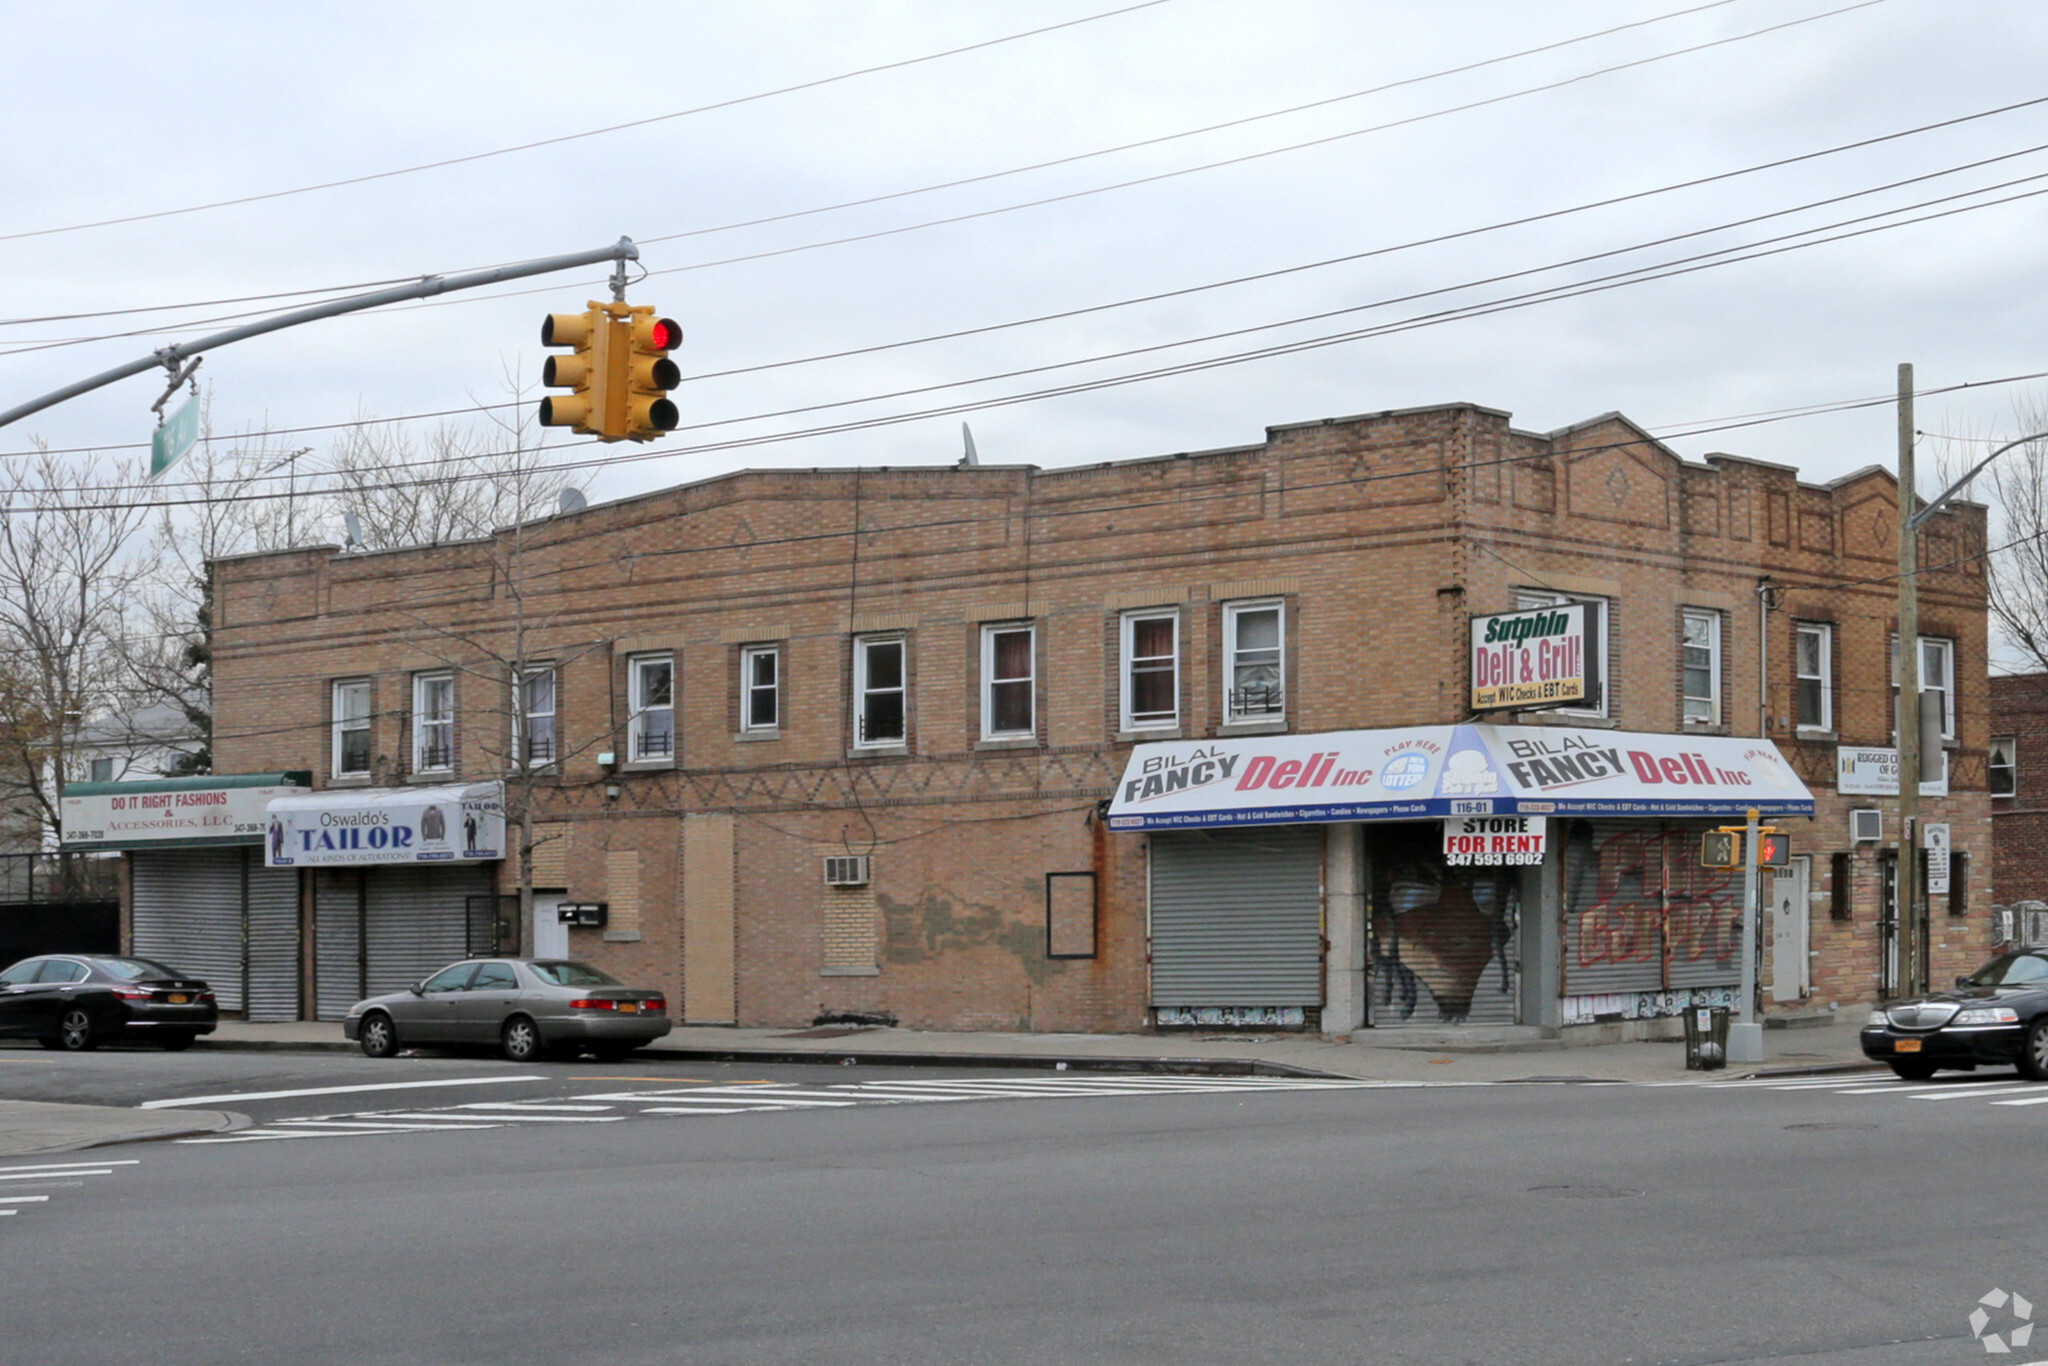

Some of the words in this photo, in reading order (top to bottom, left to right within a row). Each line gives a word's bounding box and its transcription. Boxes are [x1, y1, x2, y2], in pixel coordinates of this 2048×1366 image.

[1484, 610, 1569, 649] Sutphin
[1477, 643, 1515, 688] Deli
[1520, 647, 1534, 684] &
[1538, 635, 1581, 681] Grill
[1477, 691, 1496, 706] Accept
[1499, 686, 1514, 702] WIC
[1516, 686, 1536, 700] Checks
[1537, 684, 1543, 698] &
[1544, 682, 1560, 698] EBT
[1561, 683, 1579, 697] Cards
[1383, 740, 1413, 757] PLAY
[1415, 739, 1442, 755] HERE
[1507, 735, 1601, 759] BILAL
[1143, 745, 1226, 775] BILAL
[1857, 752, 1890, 764] RUGGED
[1124, 753, 1241, 803] FANCY
[1234, 751, 1341, 791] Deli
[1331, 768, 1373, 787] Inc
[1506, 748, 1626, 789] FANCY
[1626, 750, 1717, 785] Deli
[1714, 767, 1752, 786] Inc
[1879, 764, 1890, 775] OF
[112, 797, 125, 810] DO
[129, 796, 138, 809] IT
[142, 794, 172, 809] RIGHT
[176, 791, 228, 807] FASHIONS
[462, 802, 499, 811] TAILOR
[1456, 802, 1487, 813] 116-01
[1567, 803, 1585, 812] Accept
[1597, 803, 1615, 811] Checks
[1632, 803, 1647, 811] Cards
[1677, 804, 1704, 812] Sandwiches
[1708, 804, 1732, 812] Cigarettes
[164, 809, 173, 818] &
[203, 814, 233, 827] LLC
[320, 810, 389, 827] Oswaldo's
[1155, 816, 1172, 825] Accept
[1183, 815, 1201, 823] Checks
[1218, 813, 1233, 822] Cards
[1264, 809, 1295, 819] Sandwiches
[1299, 808, 1326, 818] Cigarettes
[1331, 807, 1352, 816] Candies
[1356, 806, 1388, 816] Newspapers
[1393, 804, 1409, 813] Phone
[1411, 803, 1426, 812] Cards
[234, 823, 266, 833] 347-368-70
[1463, 817, 1528, 833] STORE
[296, 825, 414, 852] TAILOR
[1447, 835, 1485, 853] FOR
[1492, 835, 1543, 853] RENT
[323, 854, 345, 862] KINDS
[1446, 854, 1472, 866] 347
[1474, 853, 1502, 866] 593
[1505, 853, 1543, 865] 6902
